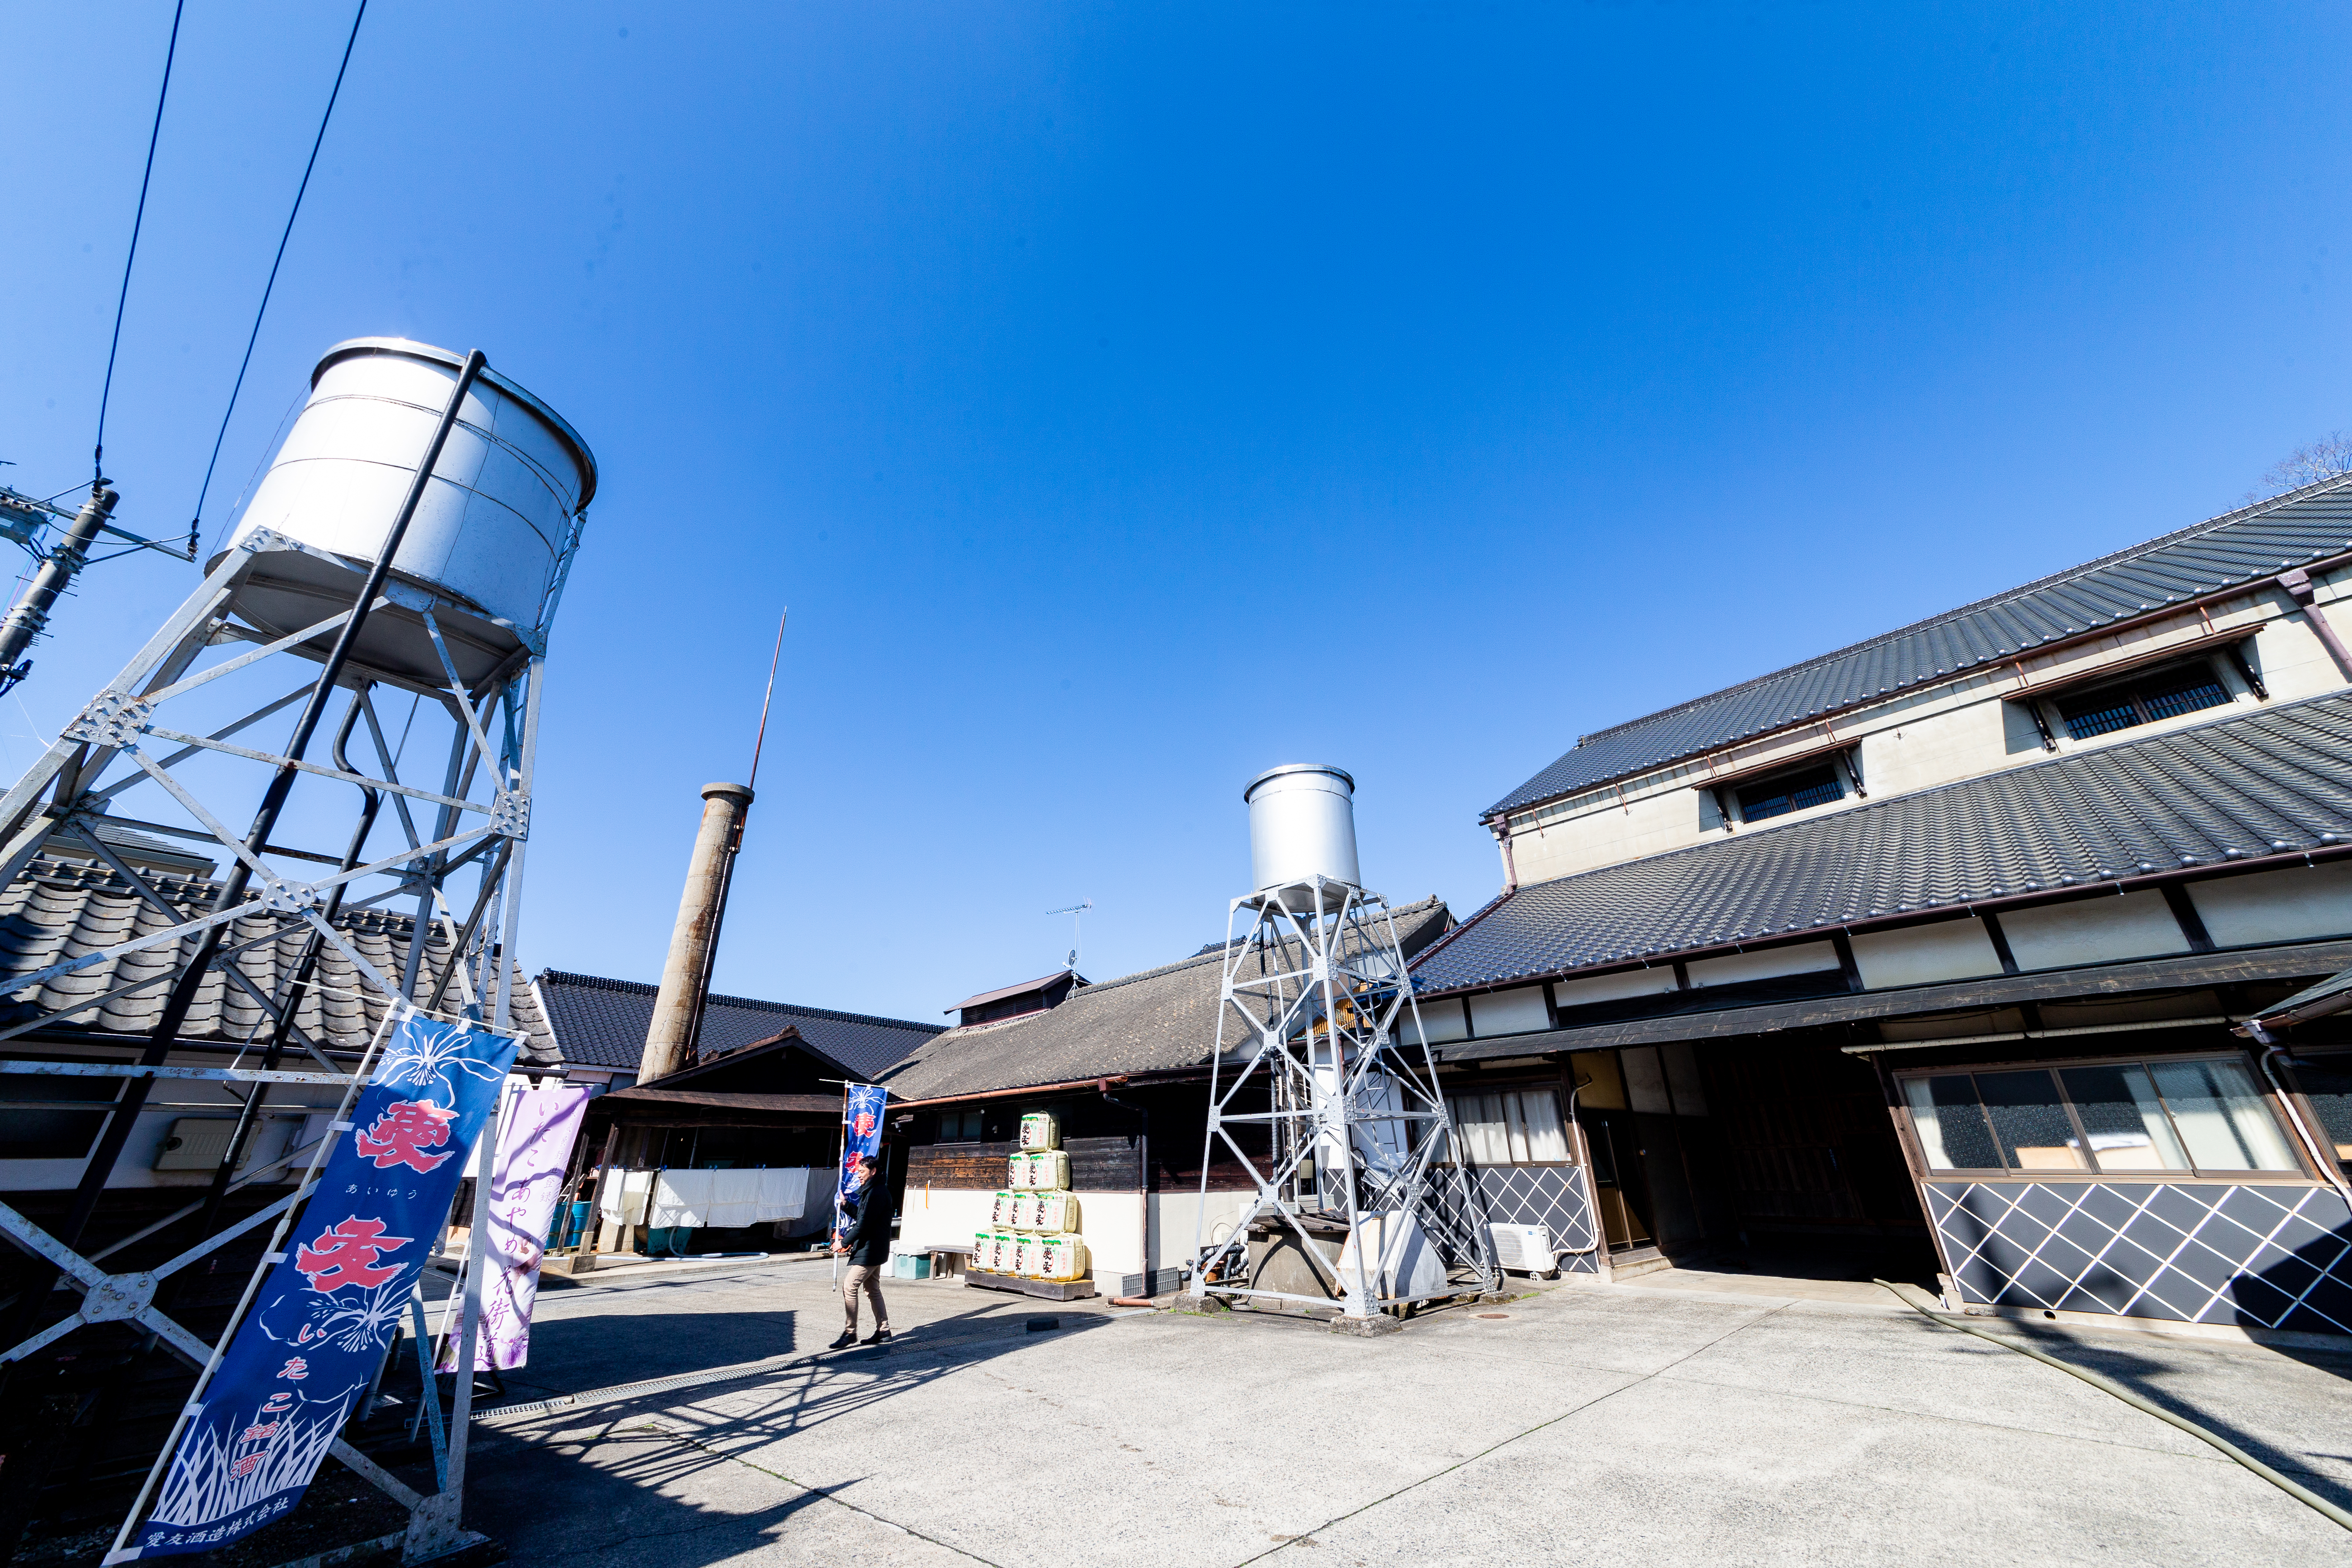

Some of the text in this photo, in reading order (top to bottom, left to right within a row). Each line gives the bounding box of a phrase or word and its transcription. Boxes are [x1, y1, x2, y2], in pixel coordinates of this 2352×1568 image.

[346, 1184, 417, 1199] あいゆう
[229, 1323, 328, 1482] いたこ銘酒
[145, 1497, 289, 1548] 愛友酒造株式会社
